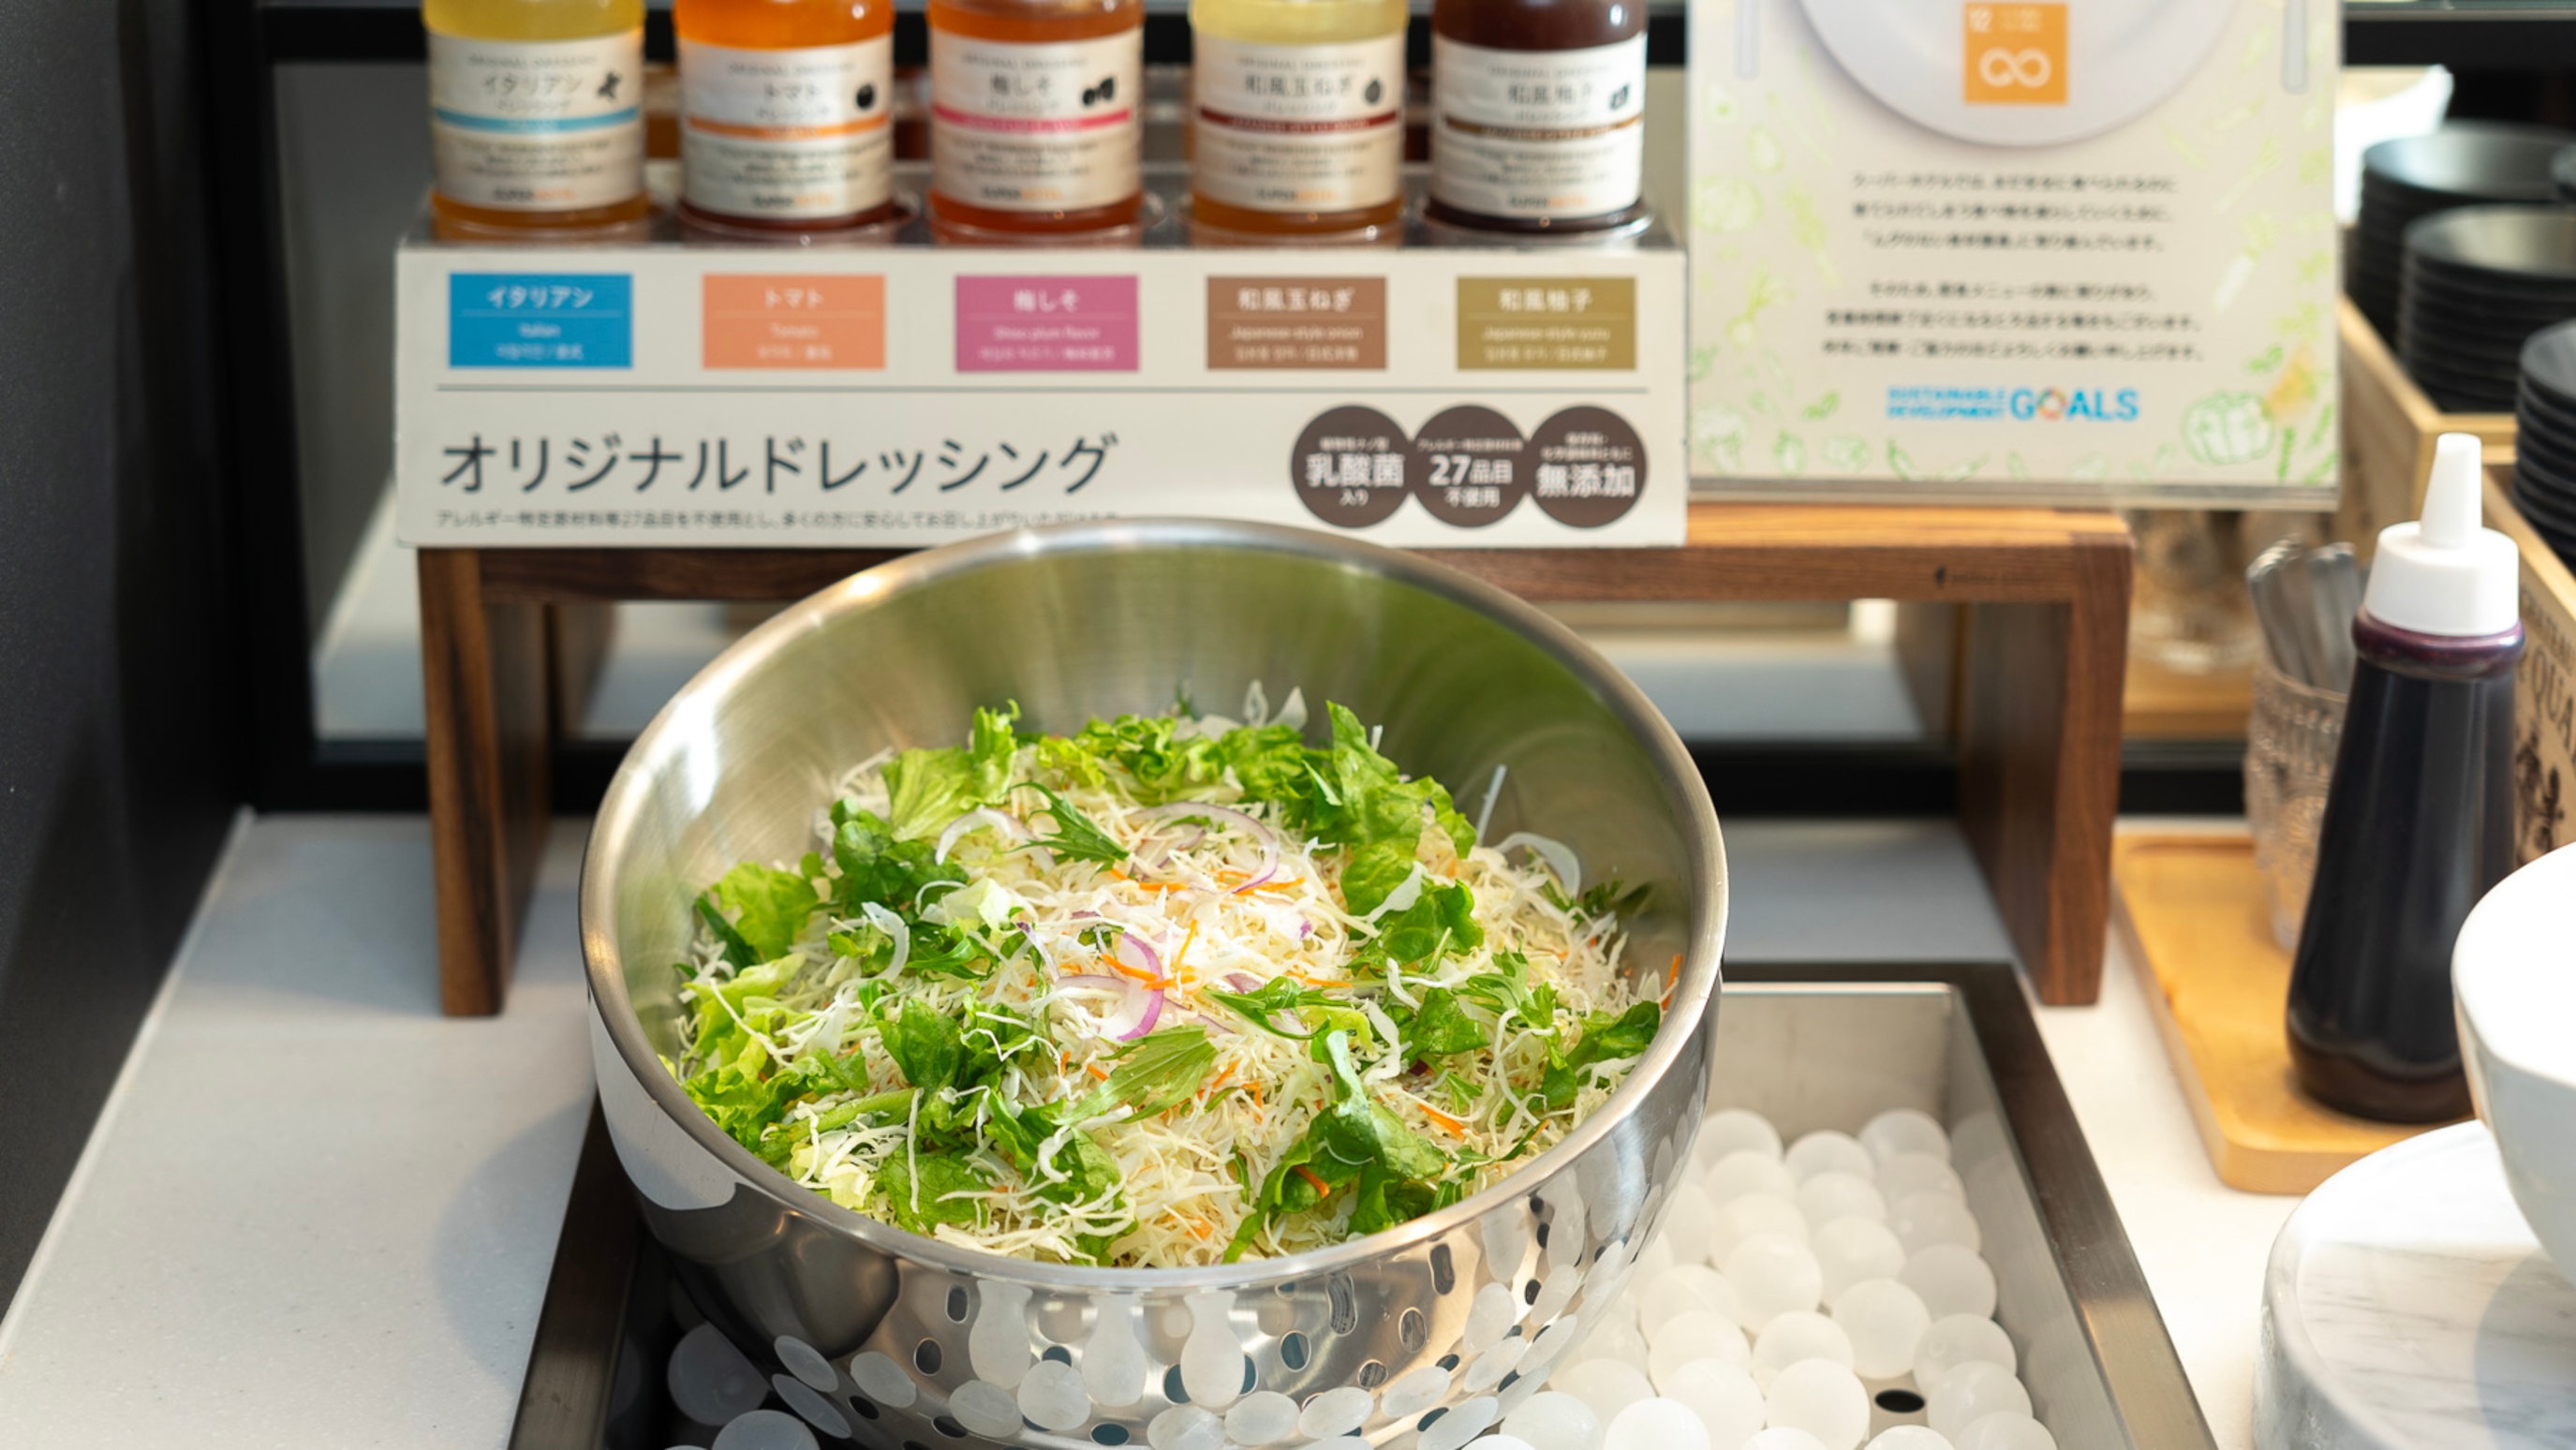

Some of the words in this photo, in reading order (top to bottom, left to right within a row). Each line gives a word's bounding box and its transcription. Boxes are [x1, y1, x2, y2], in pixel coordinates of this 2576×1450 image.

[484, 71, 583, 96] イタリアン
[764, 81, 821, 103] トマト
[991, 74, 1051, 96] 梅しそ
[1245, 74, 1353, 97] 和風玉ねぎ
[487, 285, 593, 308] イタリアン
[764, 287, 824, 310] トマト
[1014, 288, 1079, 313] 梅しそ
[1237, 287, 1355, 312] 和風玉ねぎ
[1499, 287, 1593, 312] 和風柚子
[2010, 386, 2140, 422] GOALS
[442, 431, 1119, 494] オリジナルドレッシング
[1306, 452, 1405, 487] 乳酸菌
[1429, 453, 1513, 486] 27品目
[1536, 463, 1636, 497] 無添加
[1340, 488, 1369, 506] 入り
[1444, 486, 1500, 508] 不使用
